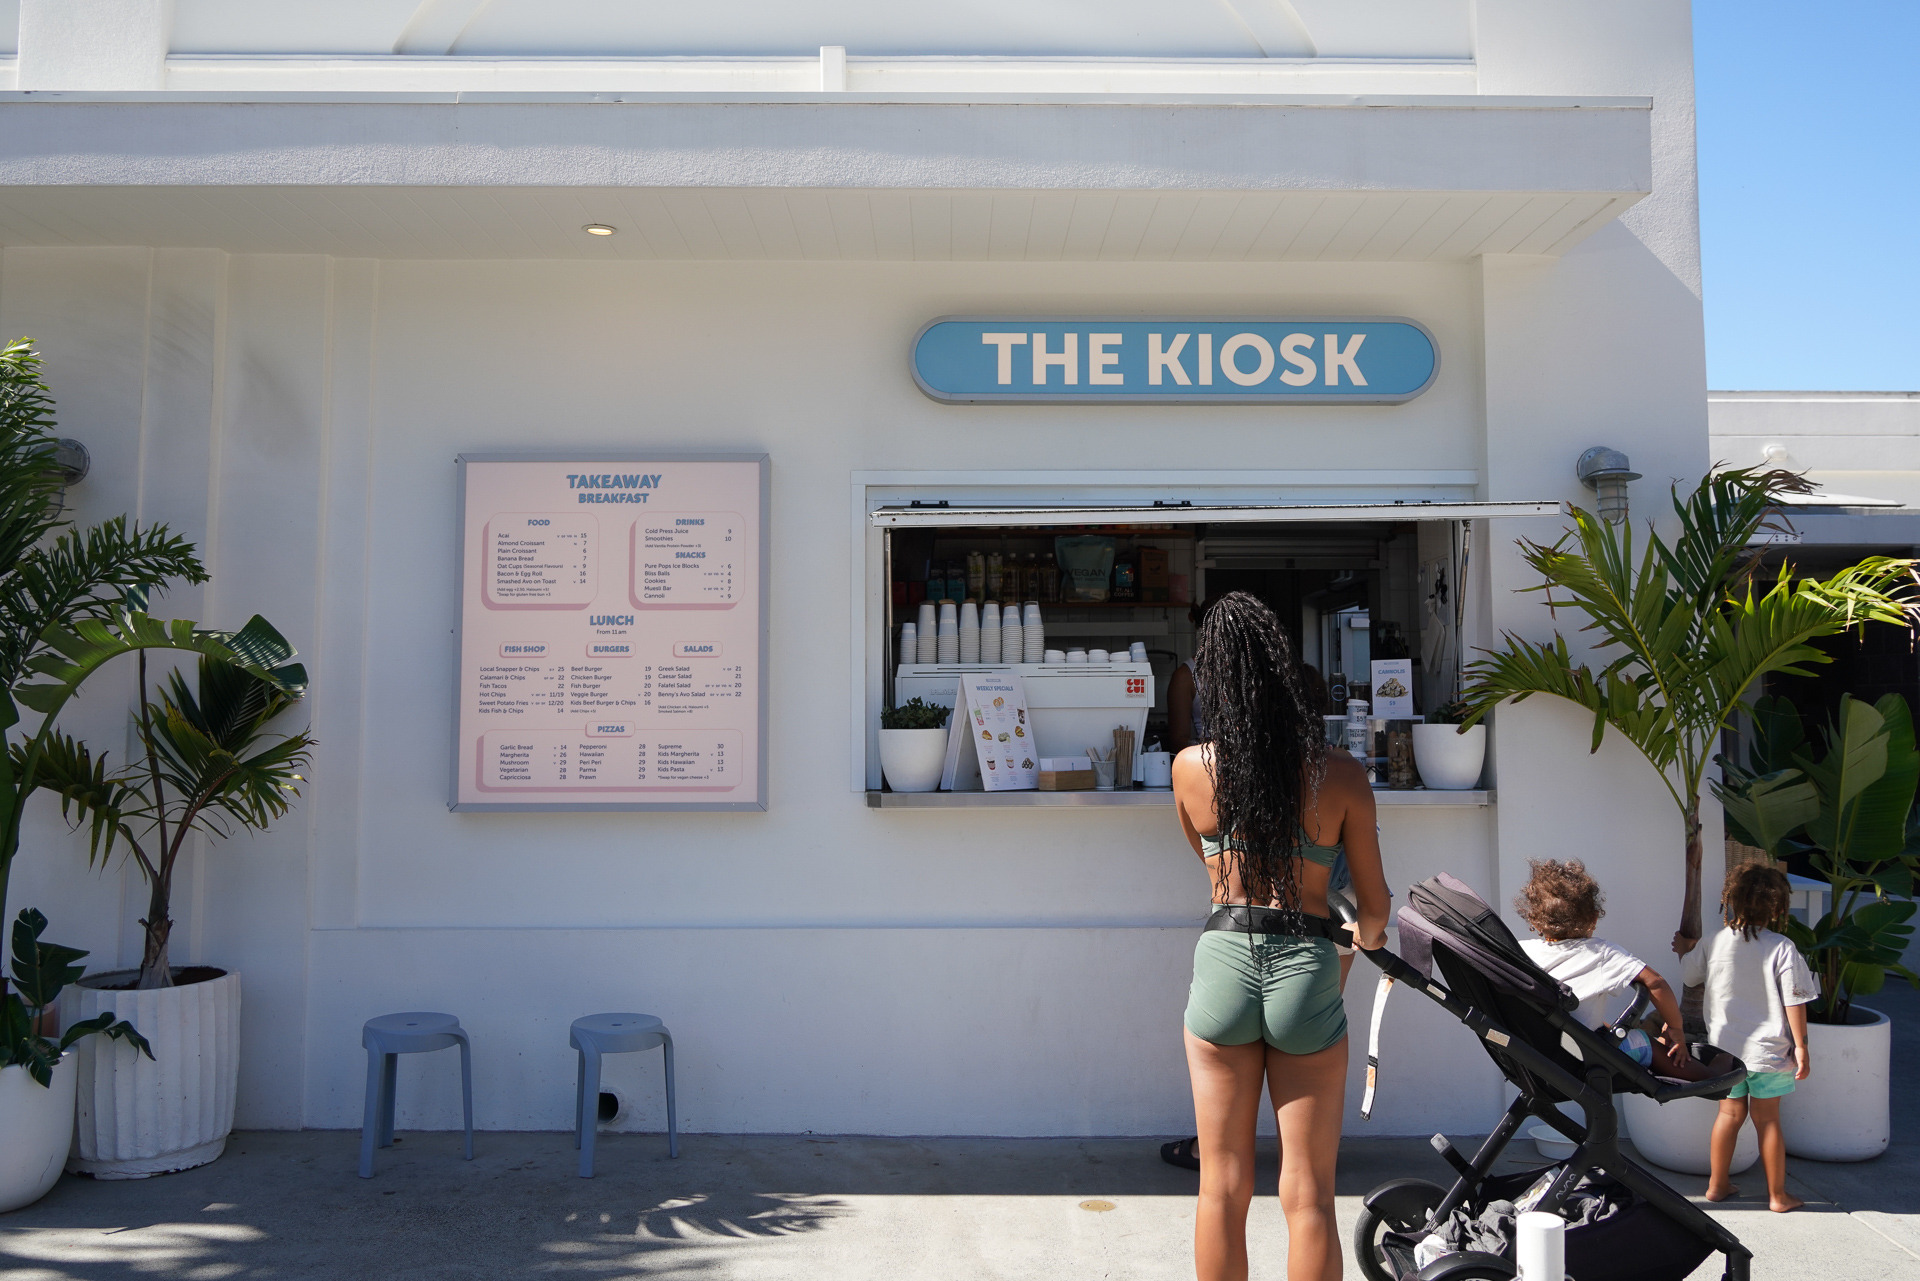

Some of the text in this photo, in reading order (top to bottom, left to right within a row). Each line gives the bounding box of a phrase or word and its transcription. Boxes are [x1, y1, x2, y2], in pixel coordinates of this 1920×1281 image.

[982, 332, 1368, 387] THE KIOSK
[566, 475, 662, 488] TAKEAWAY
[579, 493, 649, 503] BREAKFAST
[1067, 568, 1106, 576] VEGAN
[590, 616, 634, 626] LUNCH
[1556, 1174, 1576, 1200] nuna
